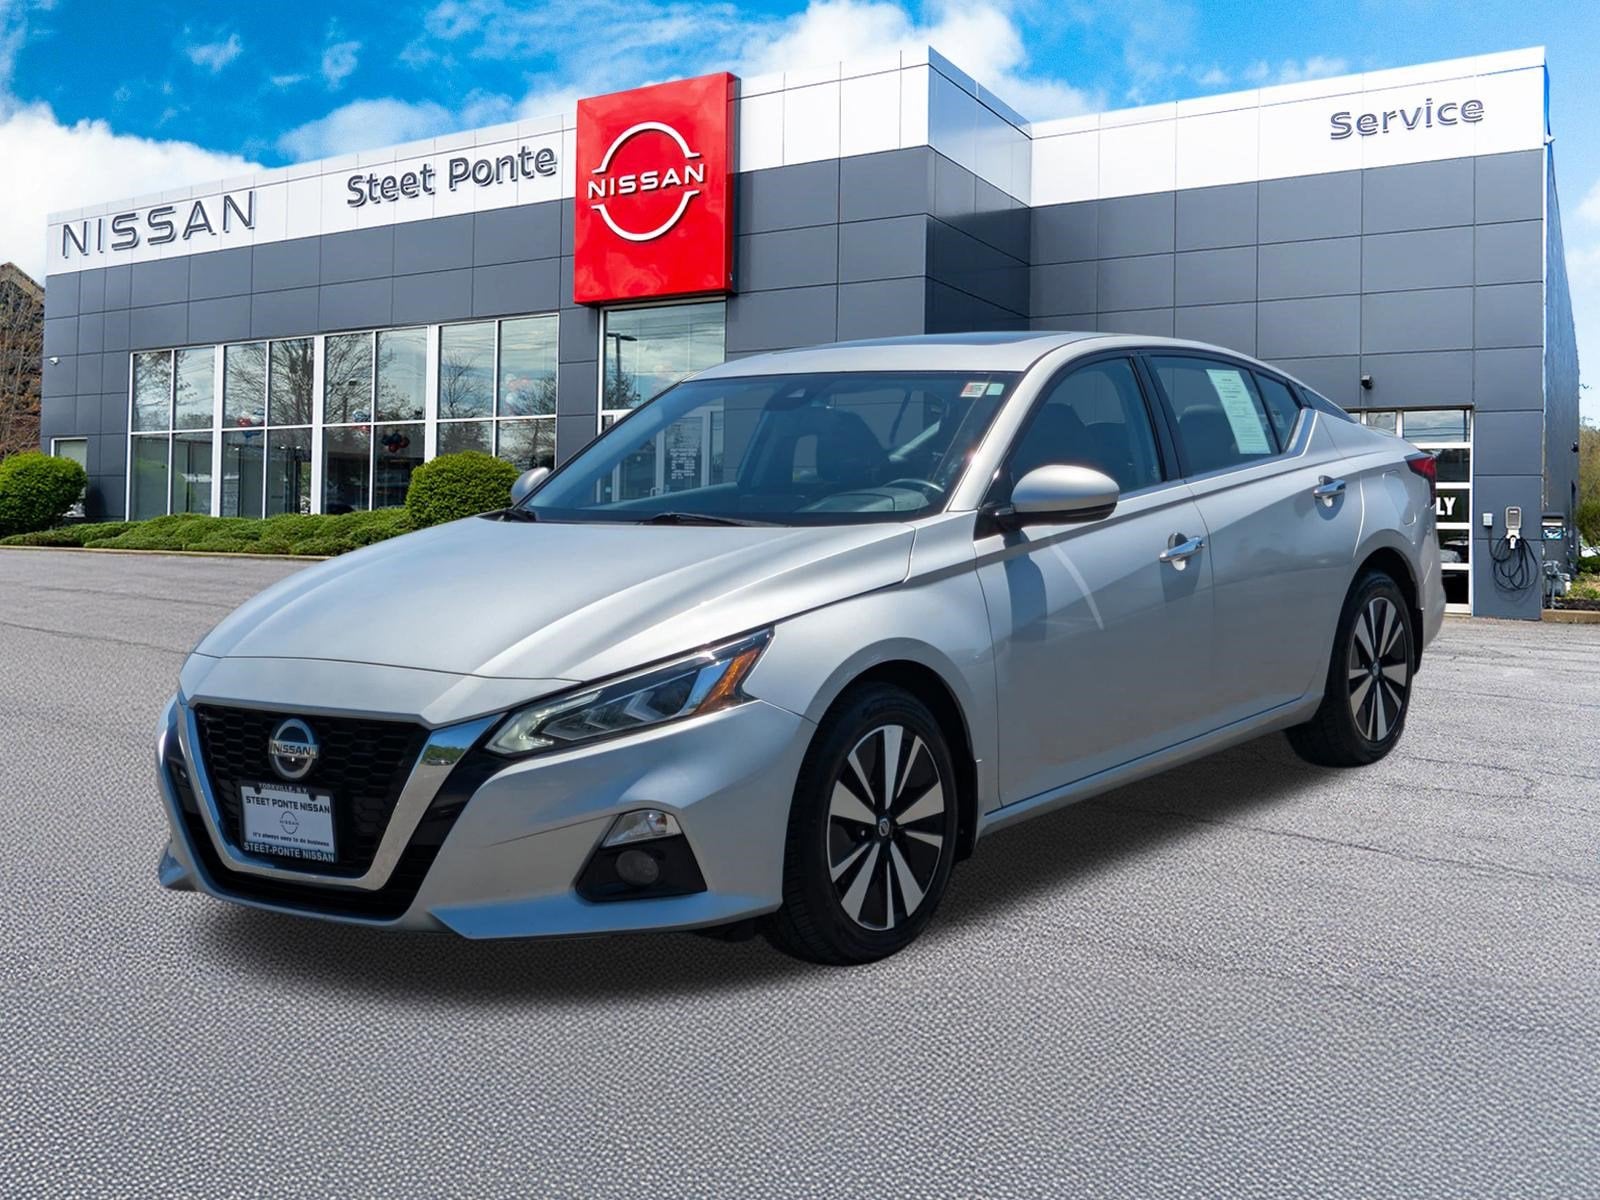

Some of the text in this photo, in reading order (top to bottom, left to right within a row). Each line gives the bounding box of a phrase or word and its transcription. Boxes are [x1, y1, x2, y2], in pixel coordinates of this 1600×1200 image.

[1330, 98, 1484, 140] Service
[347, 146, 557, 207] Steet Ponte
[587, 163, 704, 199] NISSAN
[62, 190, 255, 259] NISSAN
[1436, 497, 1456, 515] LY
[273, 743, 311, 756] NISSAN
[246, 796, 330, 813] STEET PONTE NISSAN
[244, 842, 334, 863] STEET-PONTE NISSAN
